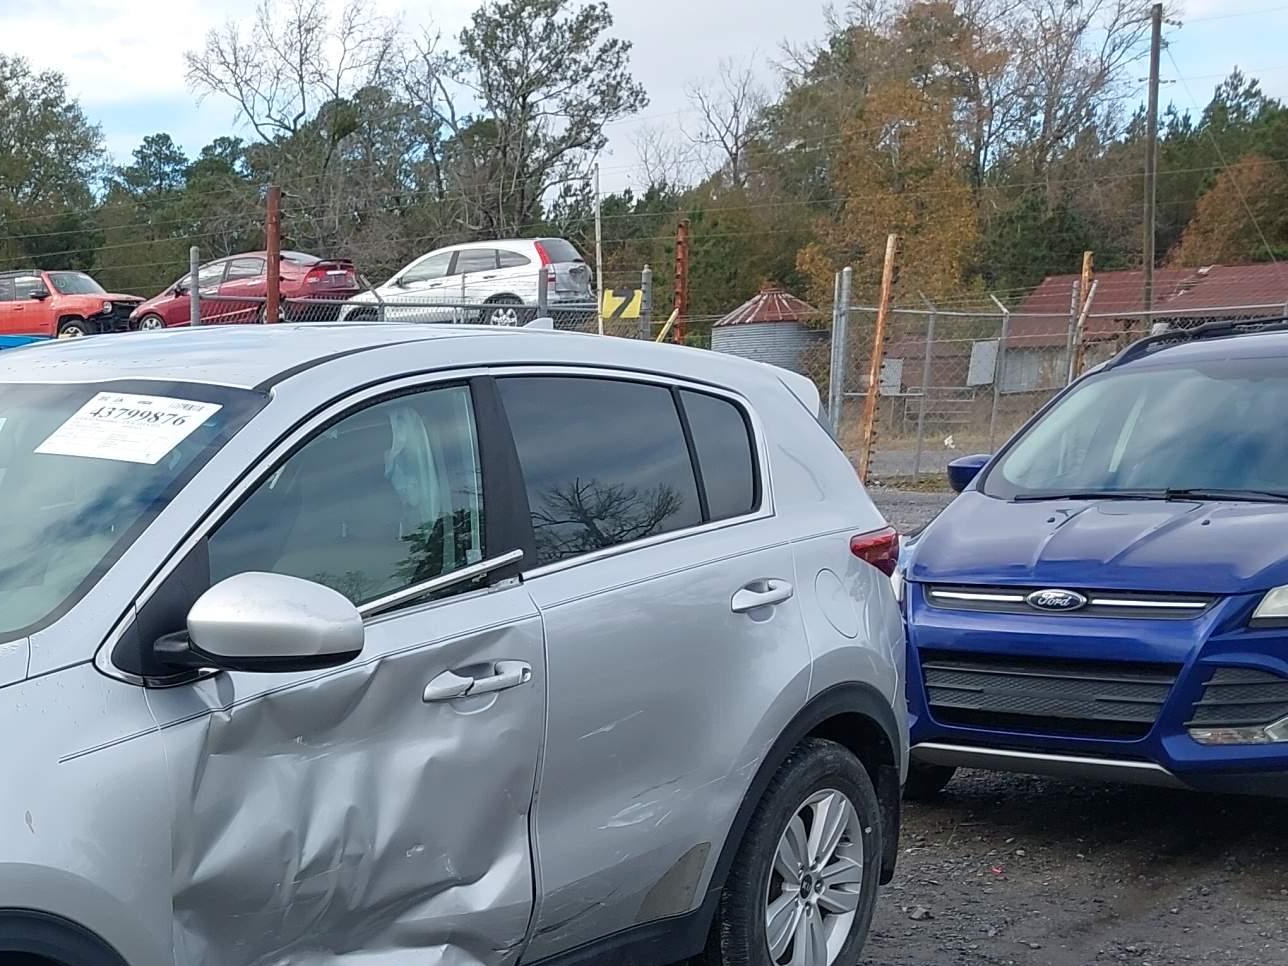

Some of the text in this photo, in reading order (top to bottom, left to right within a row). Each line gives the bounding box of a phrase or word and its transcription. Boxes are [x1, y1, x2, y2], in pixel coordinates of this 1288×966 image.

[609, 287, 635, 319] 7
[89, 405, 191, 427] 43799876
[1037, 593, 1073, 607] Ford
